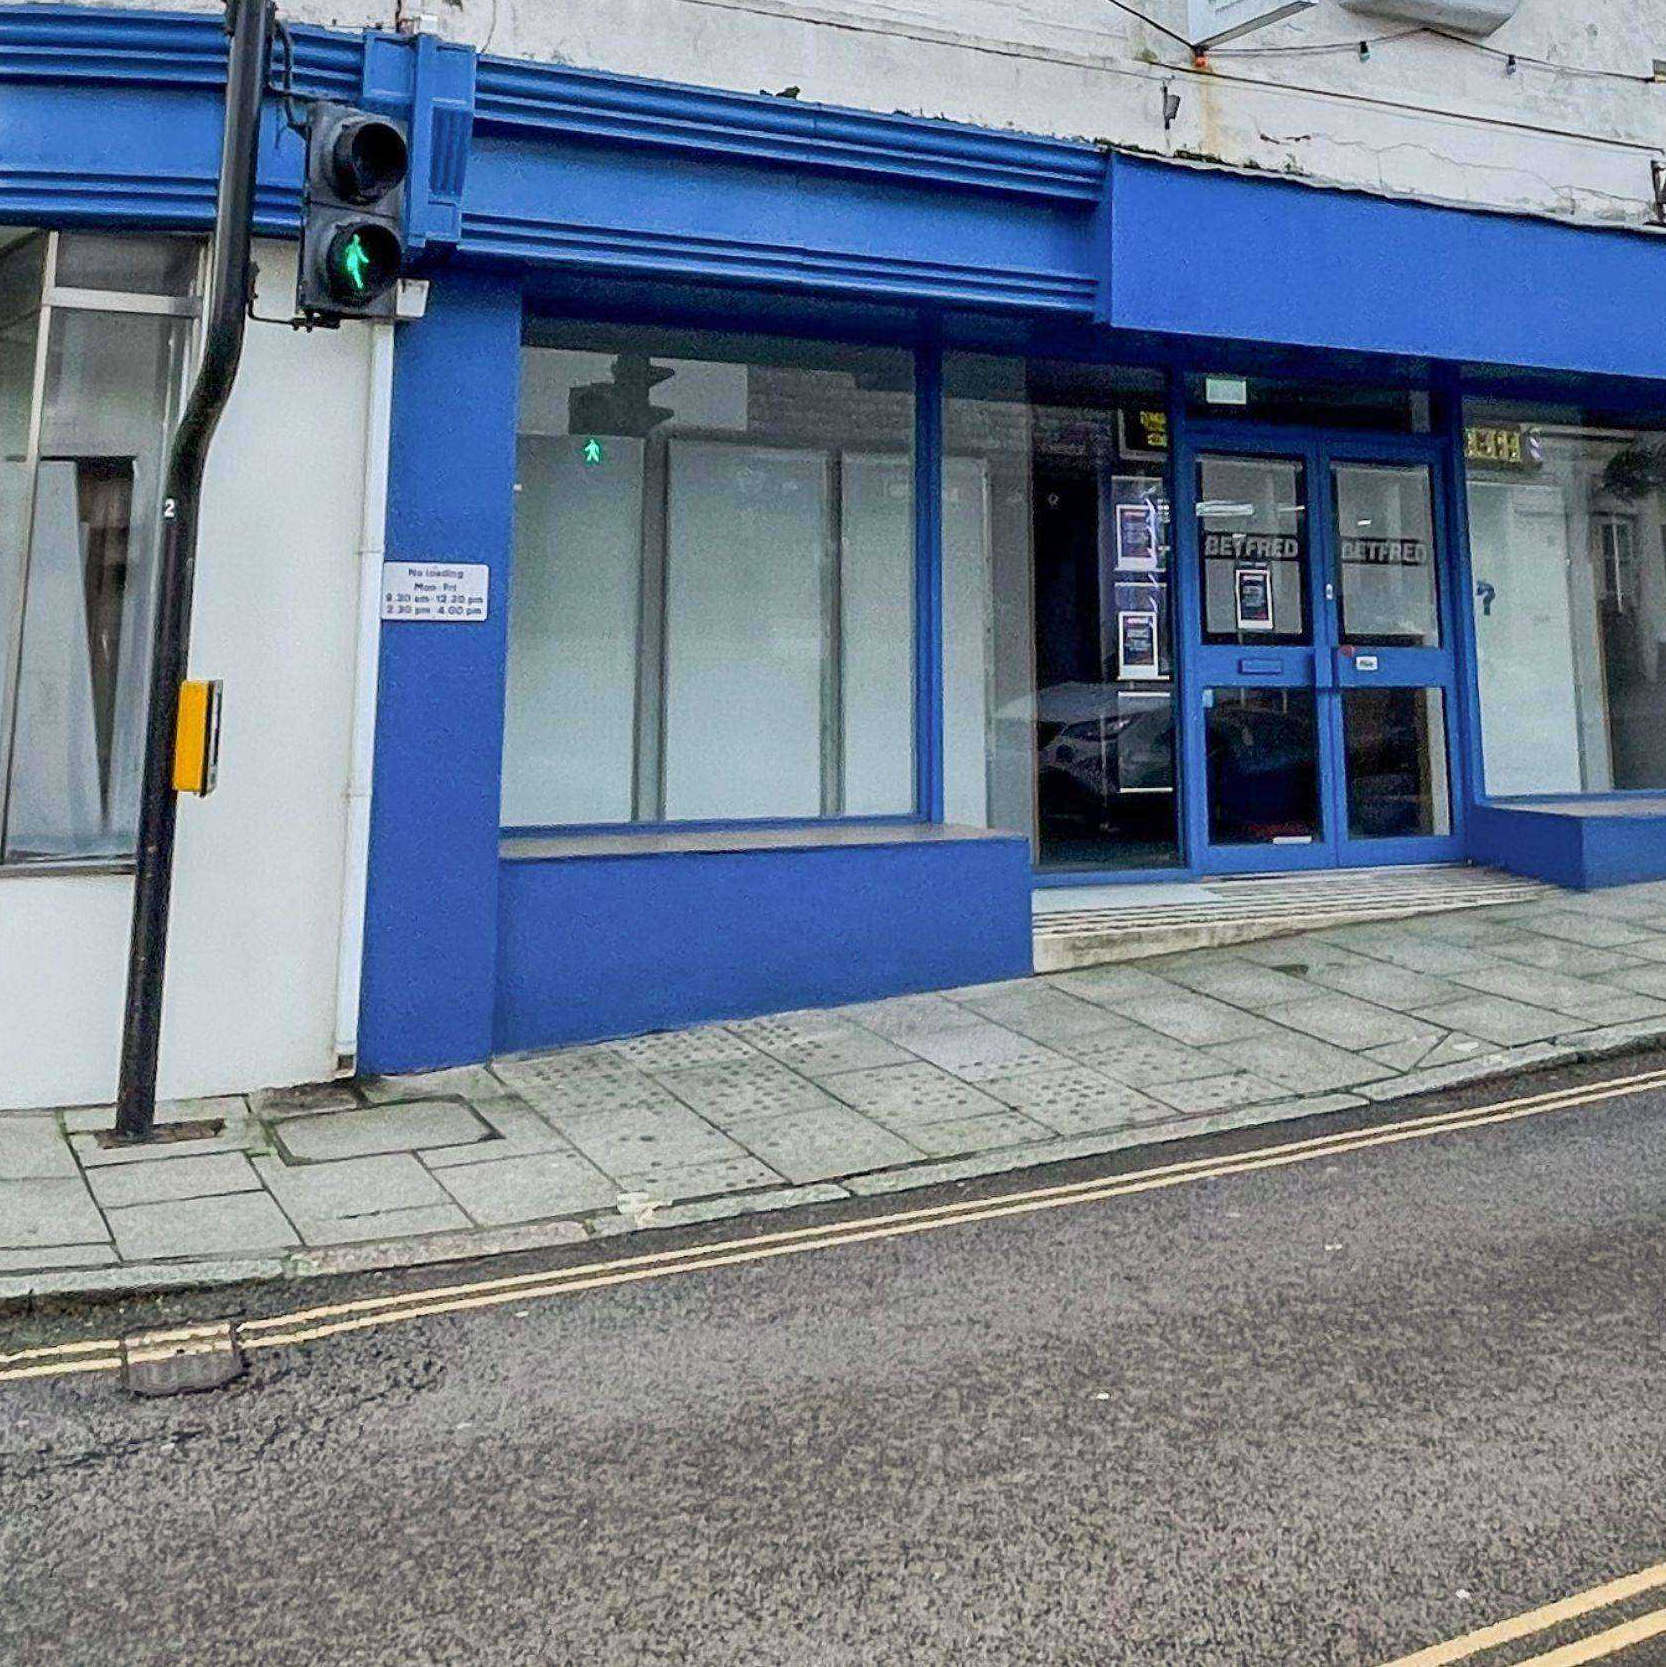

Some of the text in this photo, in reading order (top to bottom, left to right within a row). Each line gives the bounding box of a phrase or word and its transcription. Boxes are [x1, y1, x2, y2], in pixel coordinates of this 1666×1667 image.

[164, 497, 175, 518] 2
[1204, 534, 1300, 558] BETFRED
[1341, 539, 1428, 564] BETFRED
[407, 568, 464, 579] No loading
